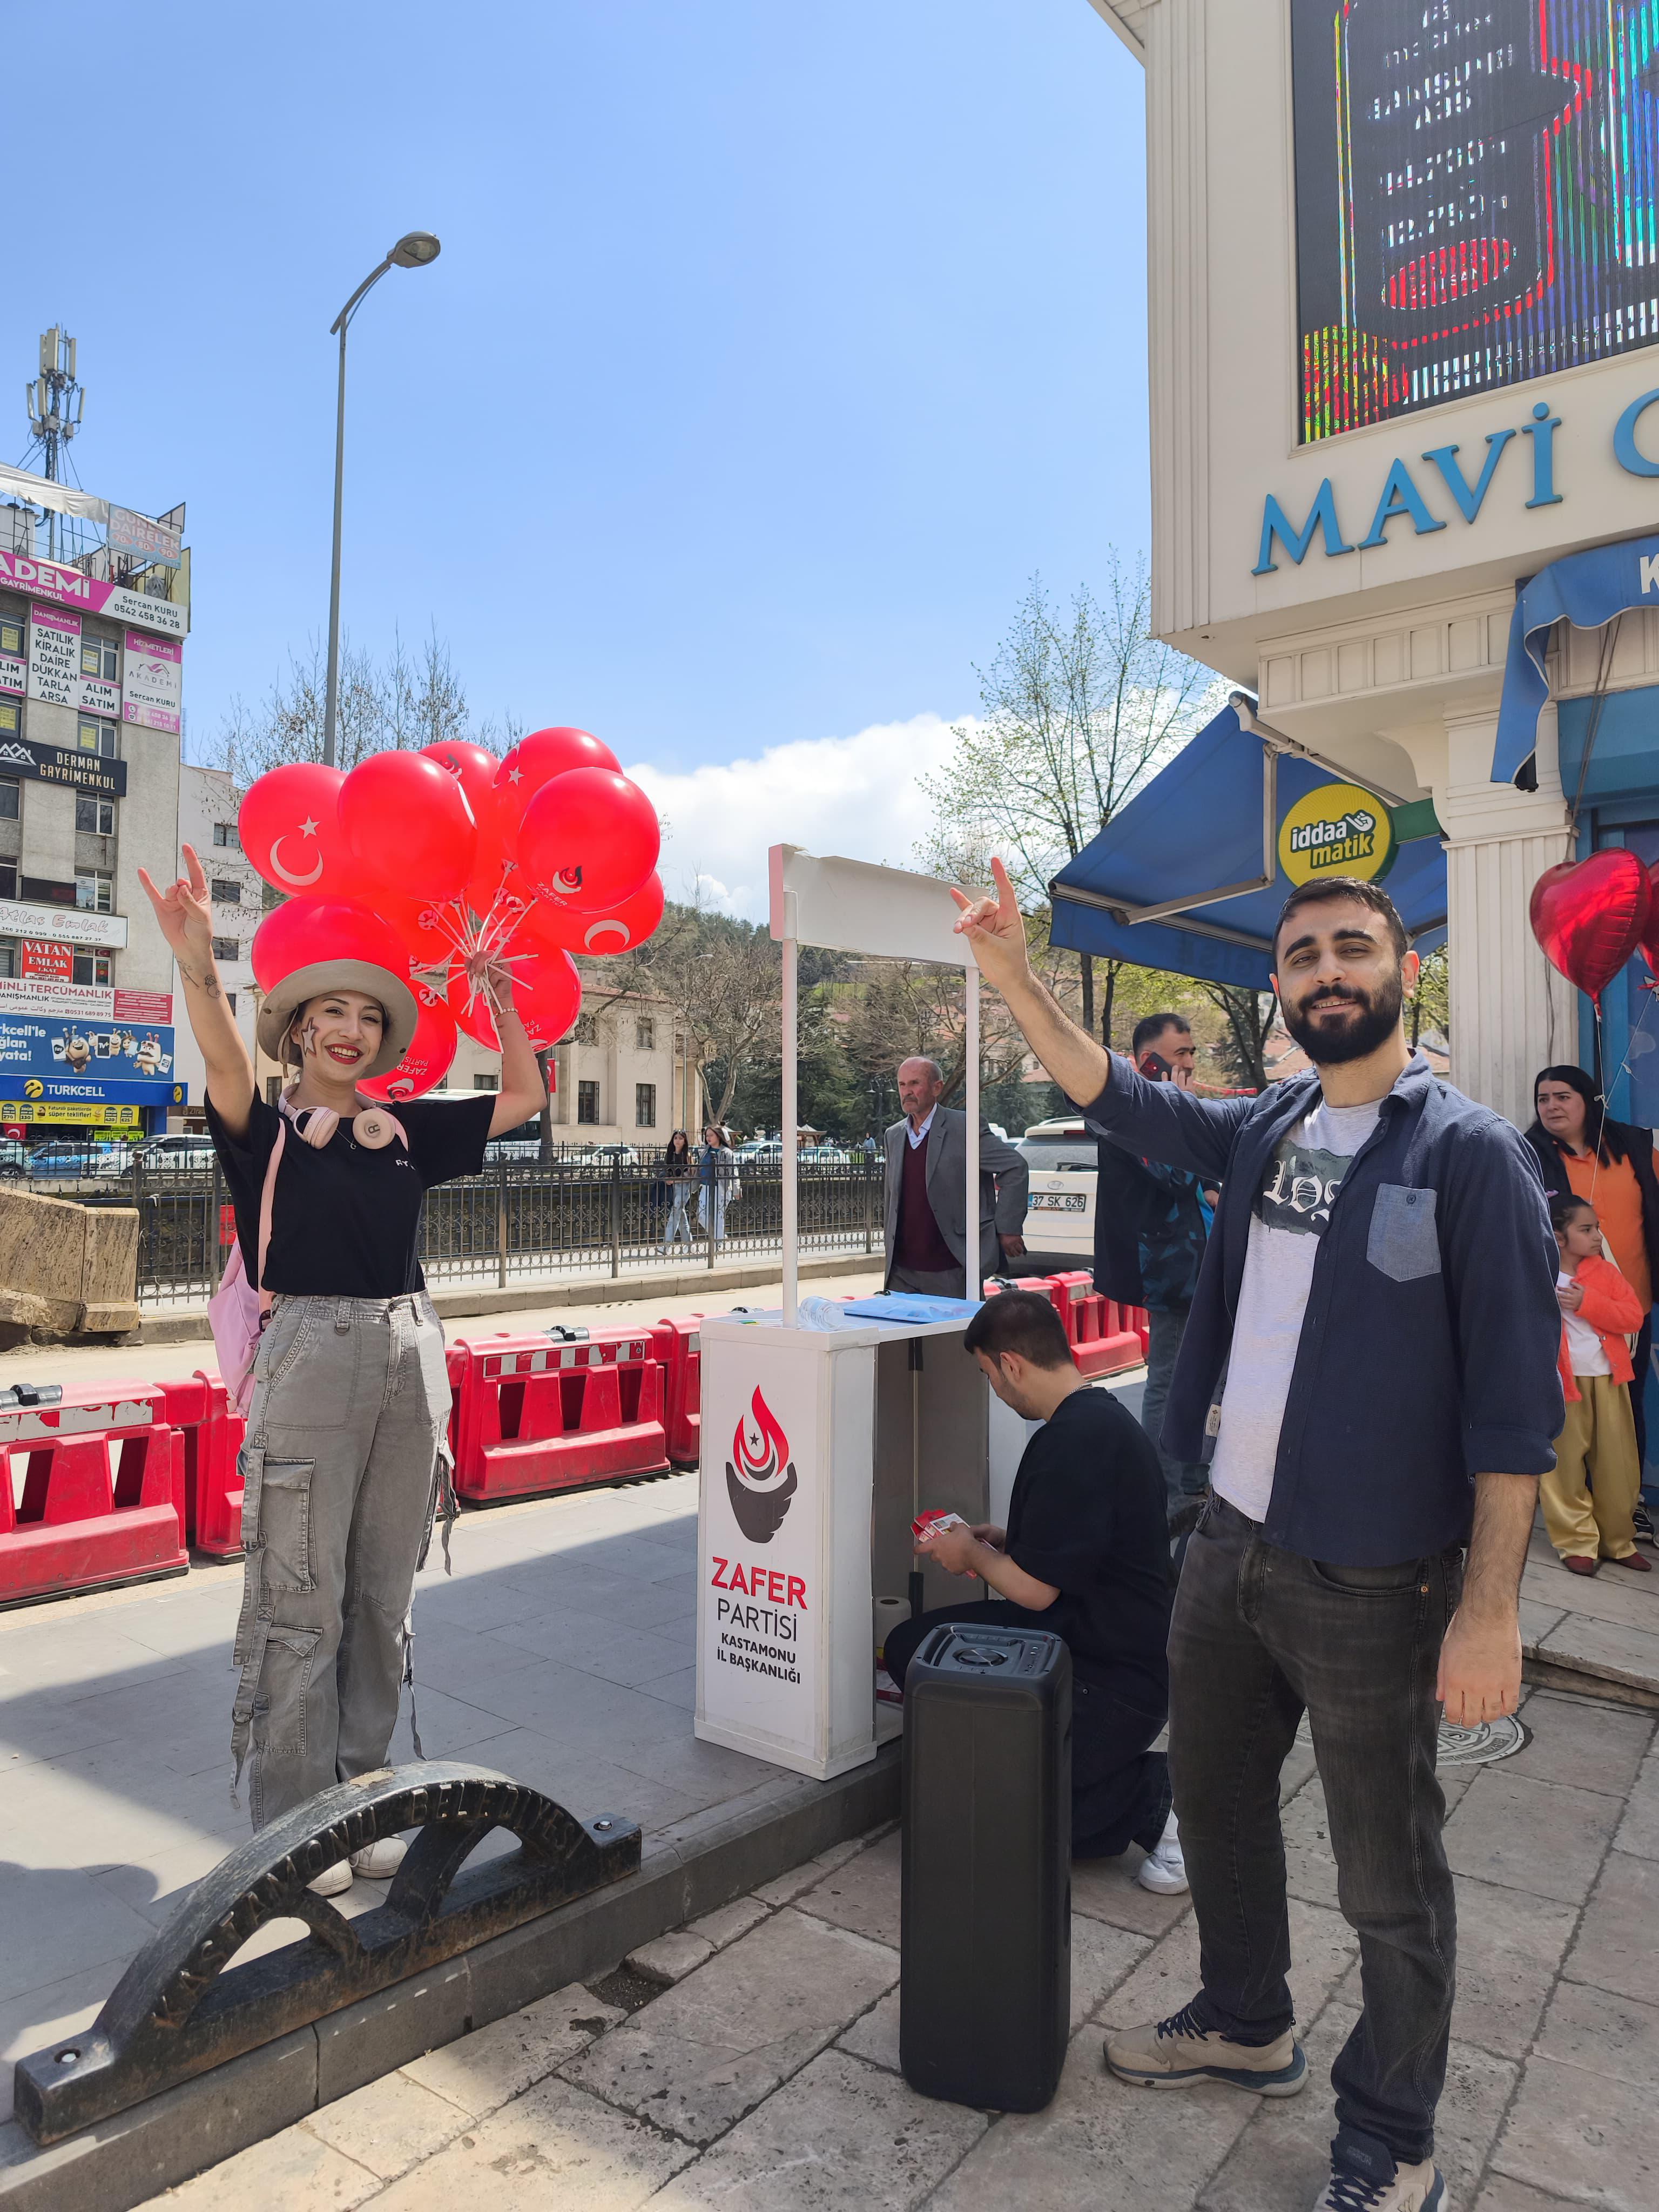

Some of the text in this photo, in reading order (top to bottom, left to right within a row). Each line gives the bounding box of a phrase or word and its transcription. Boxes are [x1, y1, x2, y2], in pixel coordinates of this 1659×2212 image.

[1251, 402, 1563, 576] MAVİ
[123, 596, 178, 617] Sercan KURU
[114, 604, 180, 629] 0542 458 36 28
[37, 628, 73, 646] SATILIK
[35, 639, 75, 658] KİRALIK
[40, 653, 71, 669] DAİRE
[32, 663, 77, 682] DÜKKAN
[0, 676, 22, 689] TIM
[37, 676, 71, 693] TARLA
[85, 683, 112, 697] ALIM
[39, 691, 68, 704] ARSA
[82, 696, 115, 711] SATIM
[130, 691, 176, 707] Sercan KURU
[57, 752, 100, 772] DERMAN
[40, 763, 115, 790] GAYRİMENKUL
[1292, 820, 1347, 850] iddaa
[1312, 833, 1372, 866] matik
[0, 907, 109, 933] Atlas Emlak
[24, 941, 72, 957] VATAN
[28, 956, 68, 968] EMLAK
[0, 993, 50, 1002] ANIŞMANLIK
[29, 983, 112, 999] TERCÜMANLIK
[396, 1062, 428, 1075] ZAFER
[47, 1084, 105, 1097] TURKCELL
[1033, 1196, 1083, 1208] 37 SK 626
[711, 1556, 808, 1610] ZAFER
[718, 1597, 797, 1642] PARTİSİ
[721, 1632, 796, 1664] KASTAMONU
[717, 1646, 800, 1684] İL BAŞKANLIĞI
